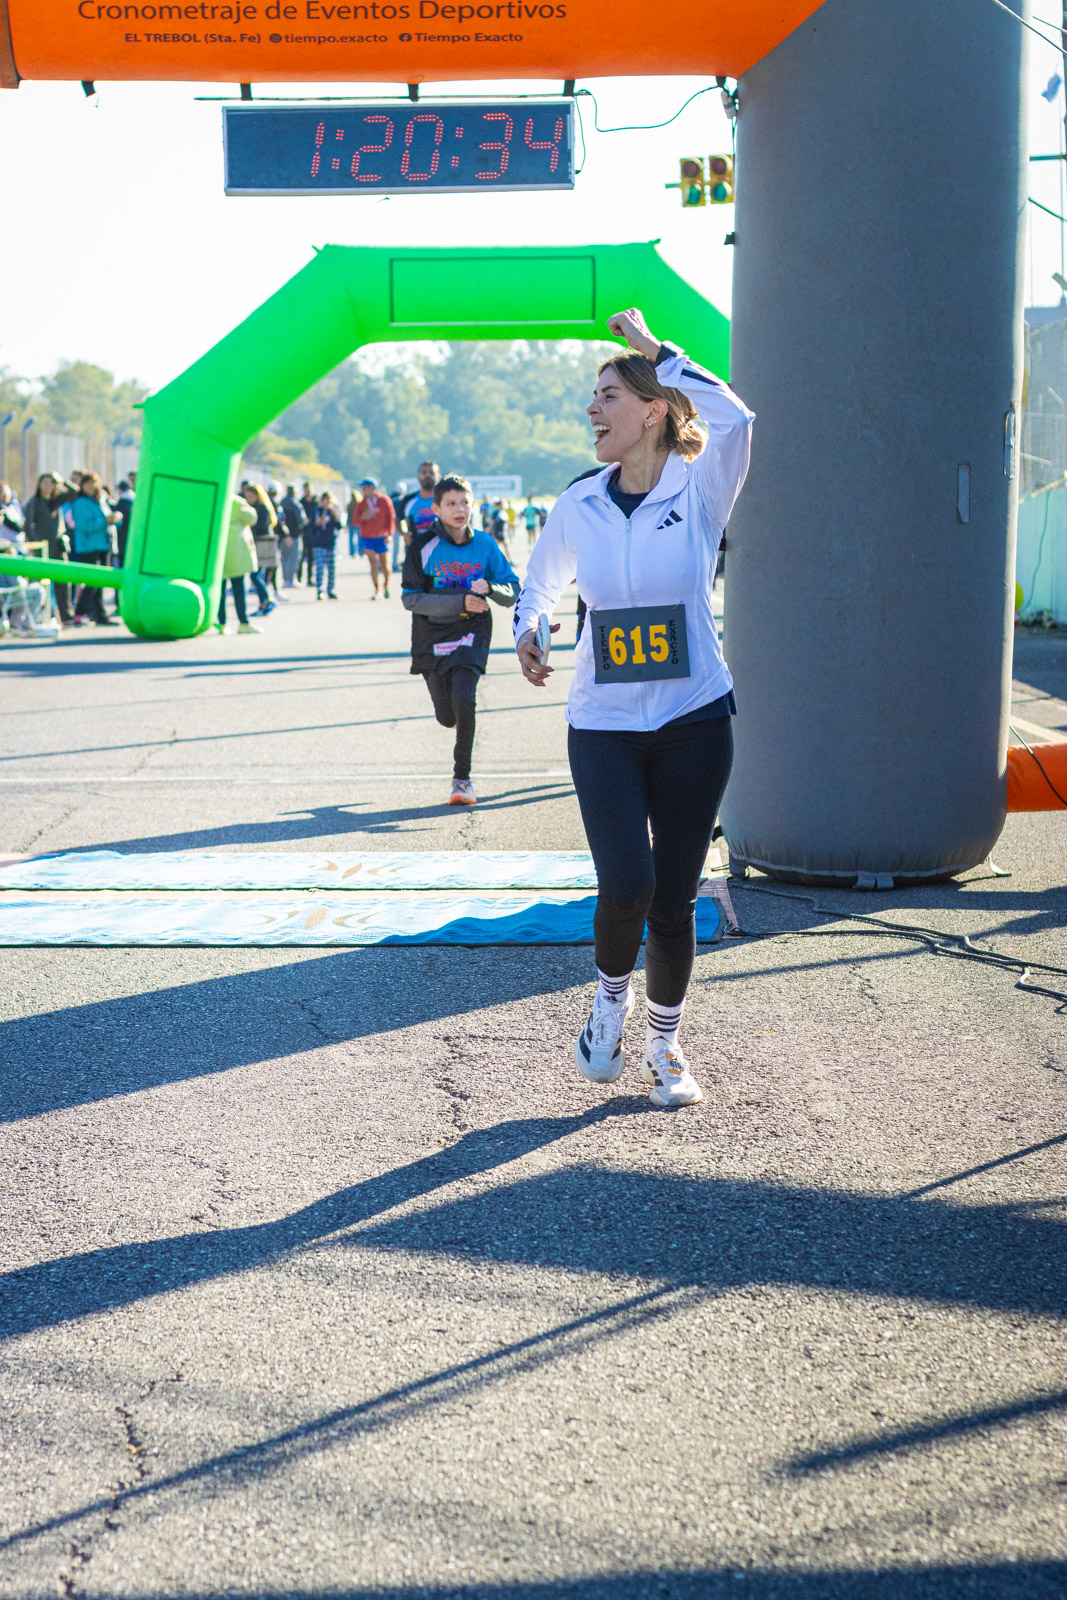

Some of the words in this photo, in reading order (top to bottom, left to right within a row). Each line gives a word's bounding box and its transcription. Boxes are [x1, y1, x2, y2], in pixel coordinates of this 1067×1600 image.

[77, 0, 258, 24] Cronometraje
[264, 0, 298, 20] de
[306, 0, 411, 20] Eventos
[418, 0, 568, 23] Deportivos
[125, 33, 142, 43] EL
[144, 33, 201, 43] TREBOL
[204, 33, 237, 44] (Sta.
[239, 33, 262, 44] Fe)
[284, 33, 388, 45] tiempo.exacto
[414, 32, 471, 44] Tiempo
[474, 32, 524, 43] Exacto
[310, 112, 565, 182] 1:20:34
[598, 625, 611, 671] TIEMPO
[608, 623, 670, 666] 615
[668, 619, 679, 666] EXACTO
